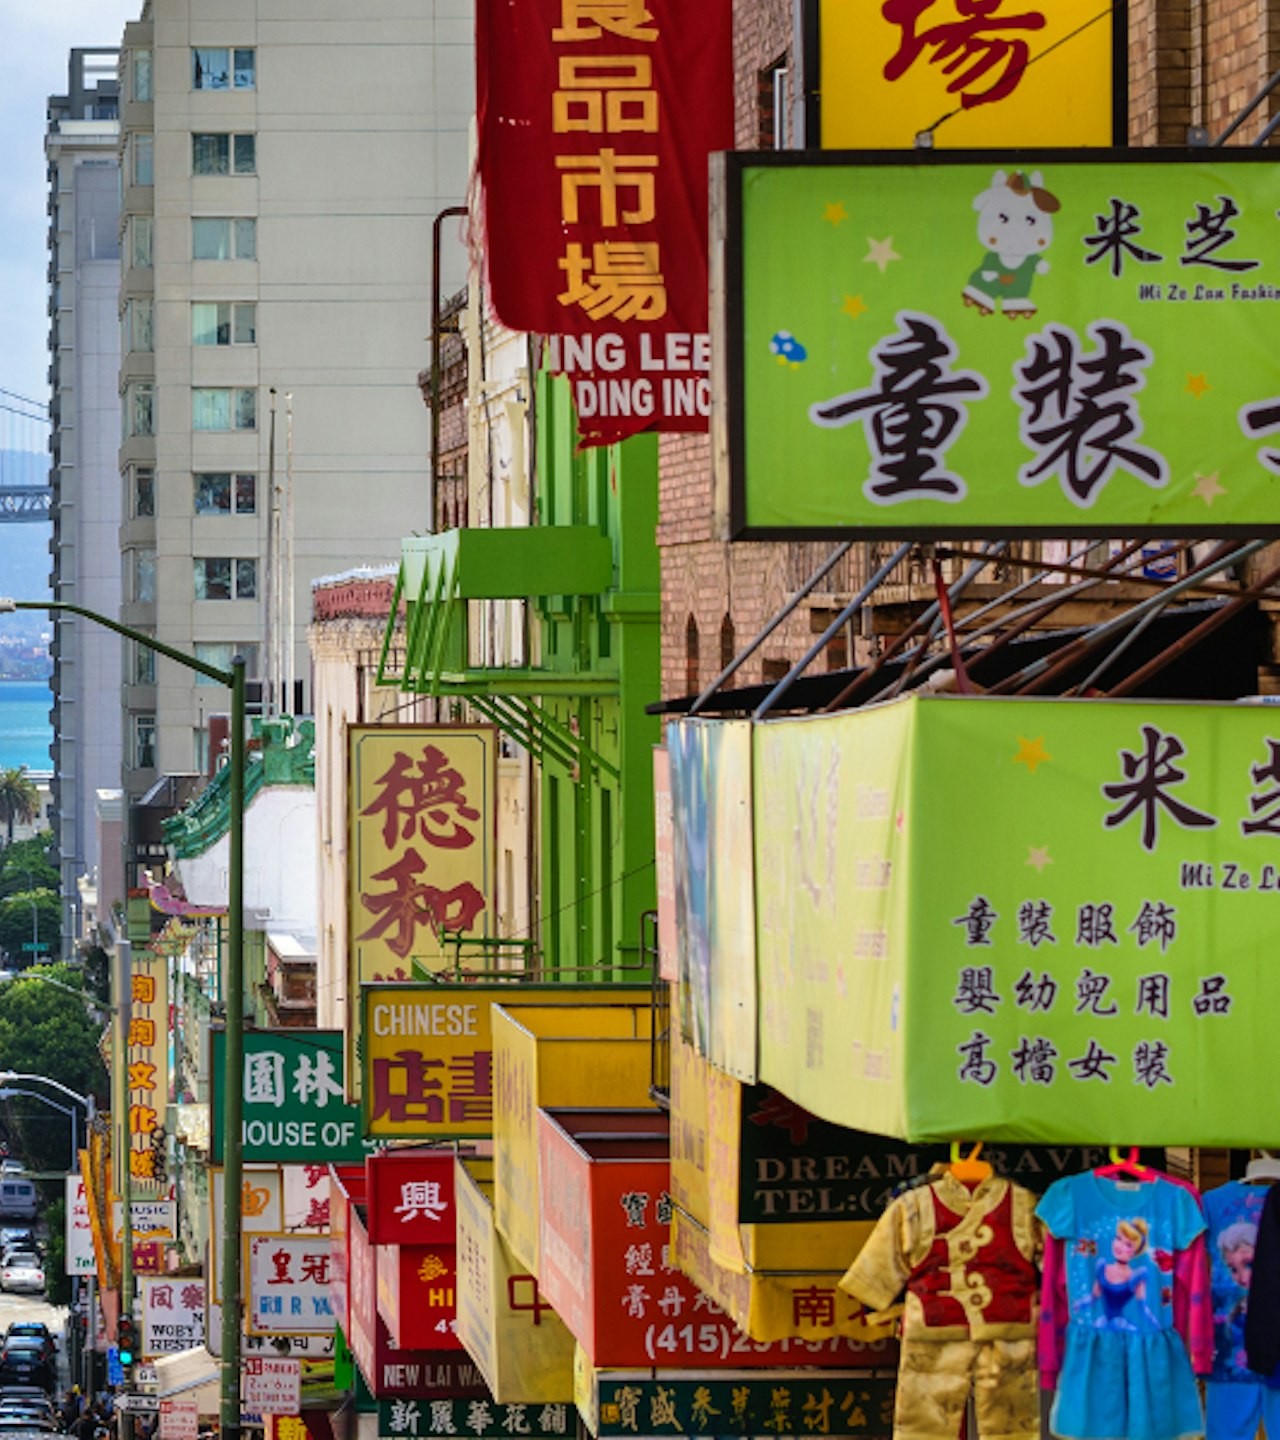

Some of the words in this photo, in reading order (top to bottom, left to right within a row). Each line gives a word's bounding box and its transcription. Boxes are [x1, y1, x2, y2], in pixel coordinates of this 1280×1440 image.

[1182, 863, 1213, 889] Mi
[1222, 864, 1250, 889] Ze
[954, 897, 1177, 951] 童裝服飾
[954, 966, 1231, 1019] 嬰幼兒用品
[373, 1004, 478, 1037] CHINESE
[958, 1032, 1174, 1088] 高檔女裝
[321, 1120, 355, 1147] OF
[756, 1152, 920, 1184] DREAM
[393, 1181, 448, 1223] 興
[383, 1364, 420, 1387] NEW
[424, 1364, 452, 1387] LAI
